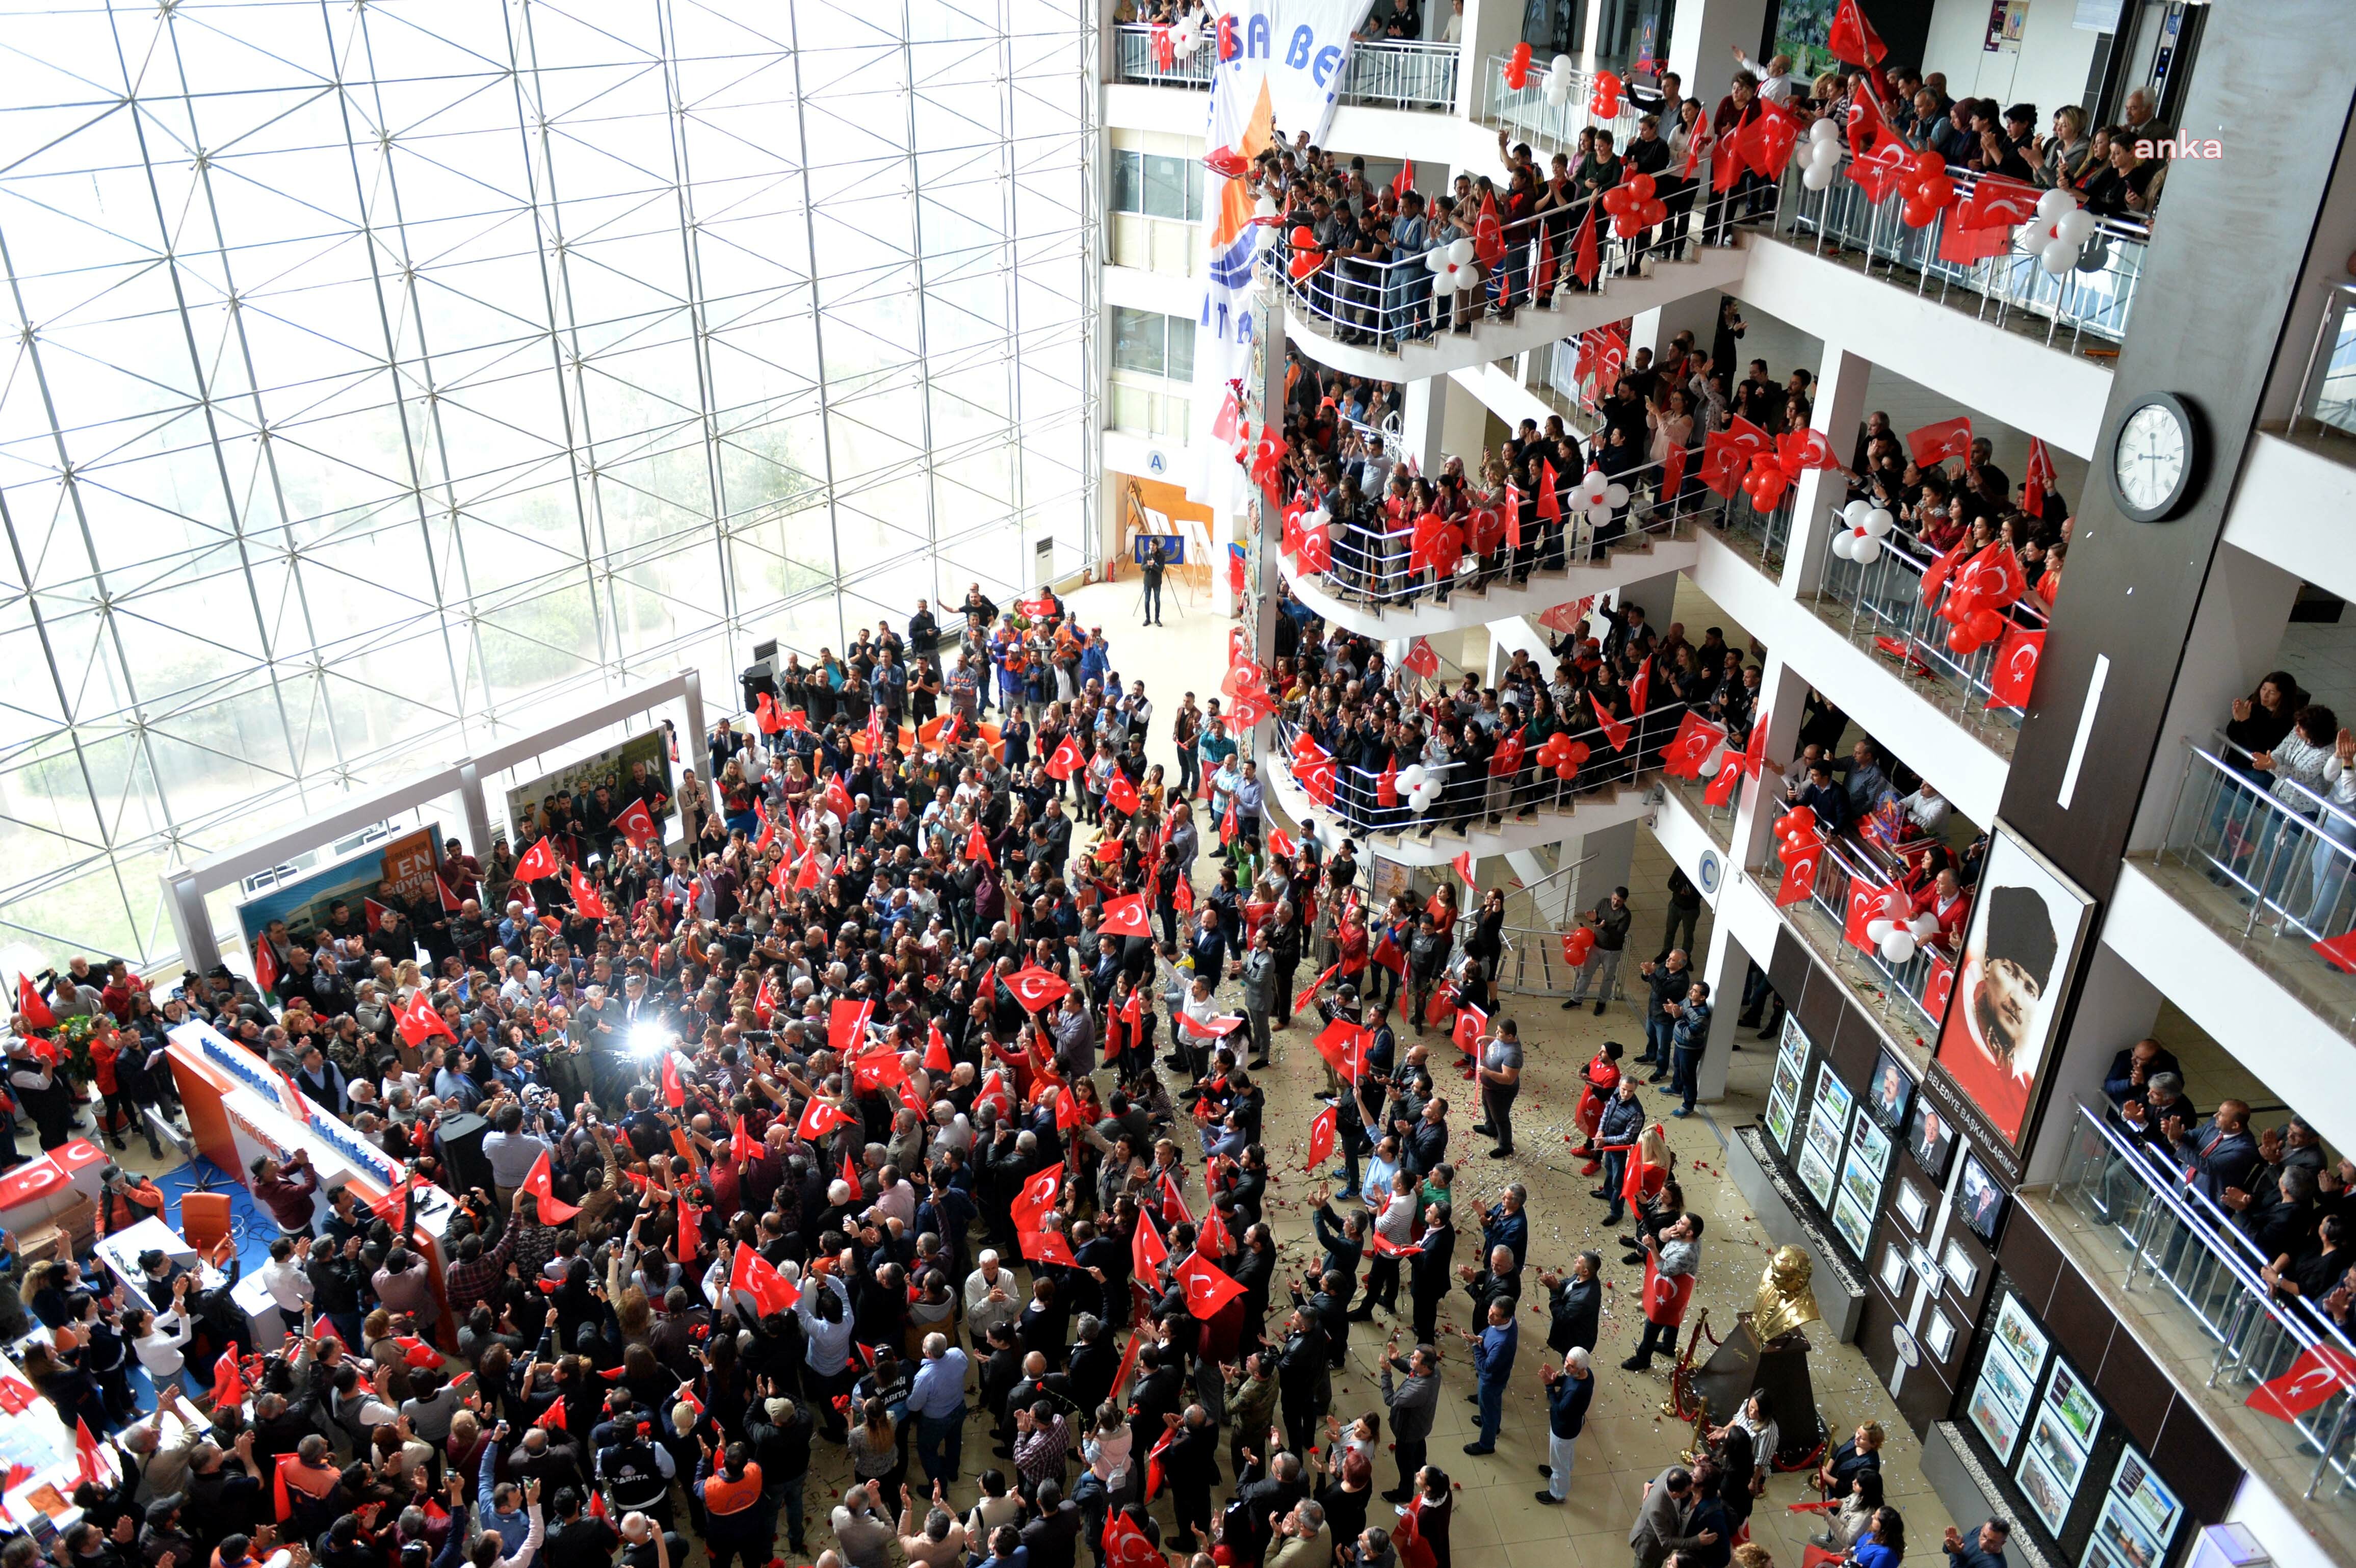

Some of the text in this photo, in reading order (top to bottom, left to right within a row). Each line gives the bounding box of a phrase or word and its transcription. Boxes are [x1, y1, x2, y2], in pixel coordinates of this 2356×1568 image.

[1150, 454, 1162, 470] A
[398, 850, 431, 877] EN
[1703, 859, 1716, 886] C
[1927, 1070, 1961, 1113] BELEDİYE
[1959, 1107, 2019, 1179] BAŞKANLARIMIZ
[881, 1389, 907, 1405] ABITA
[612, 1474, 649, 1484] ZABITA
